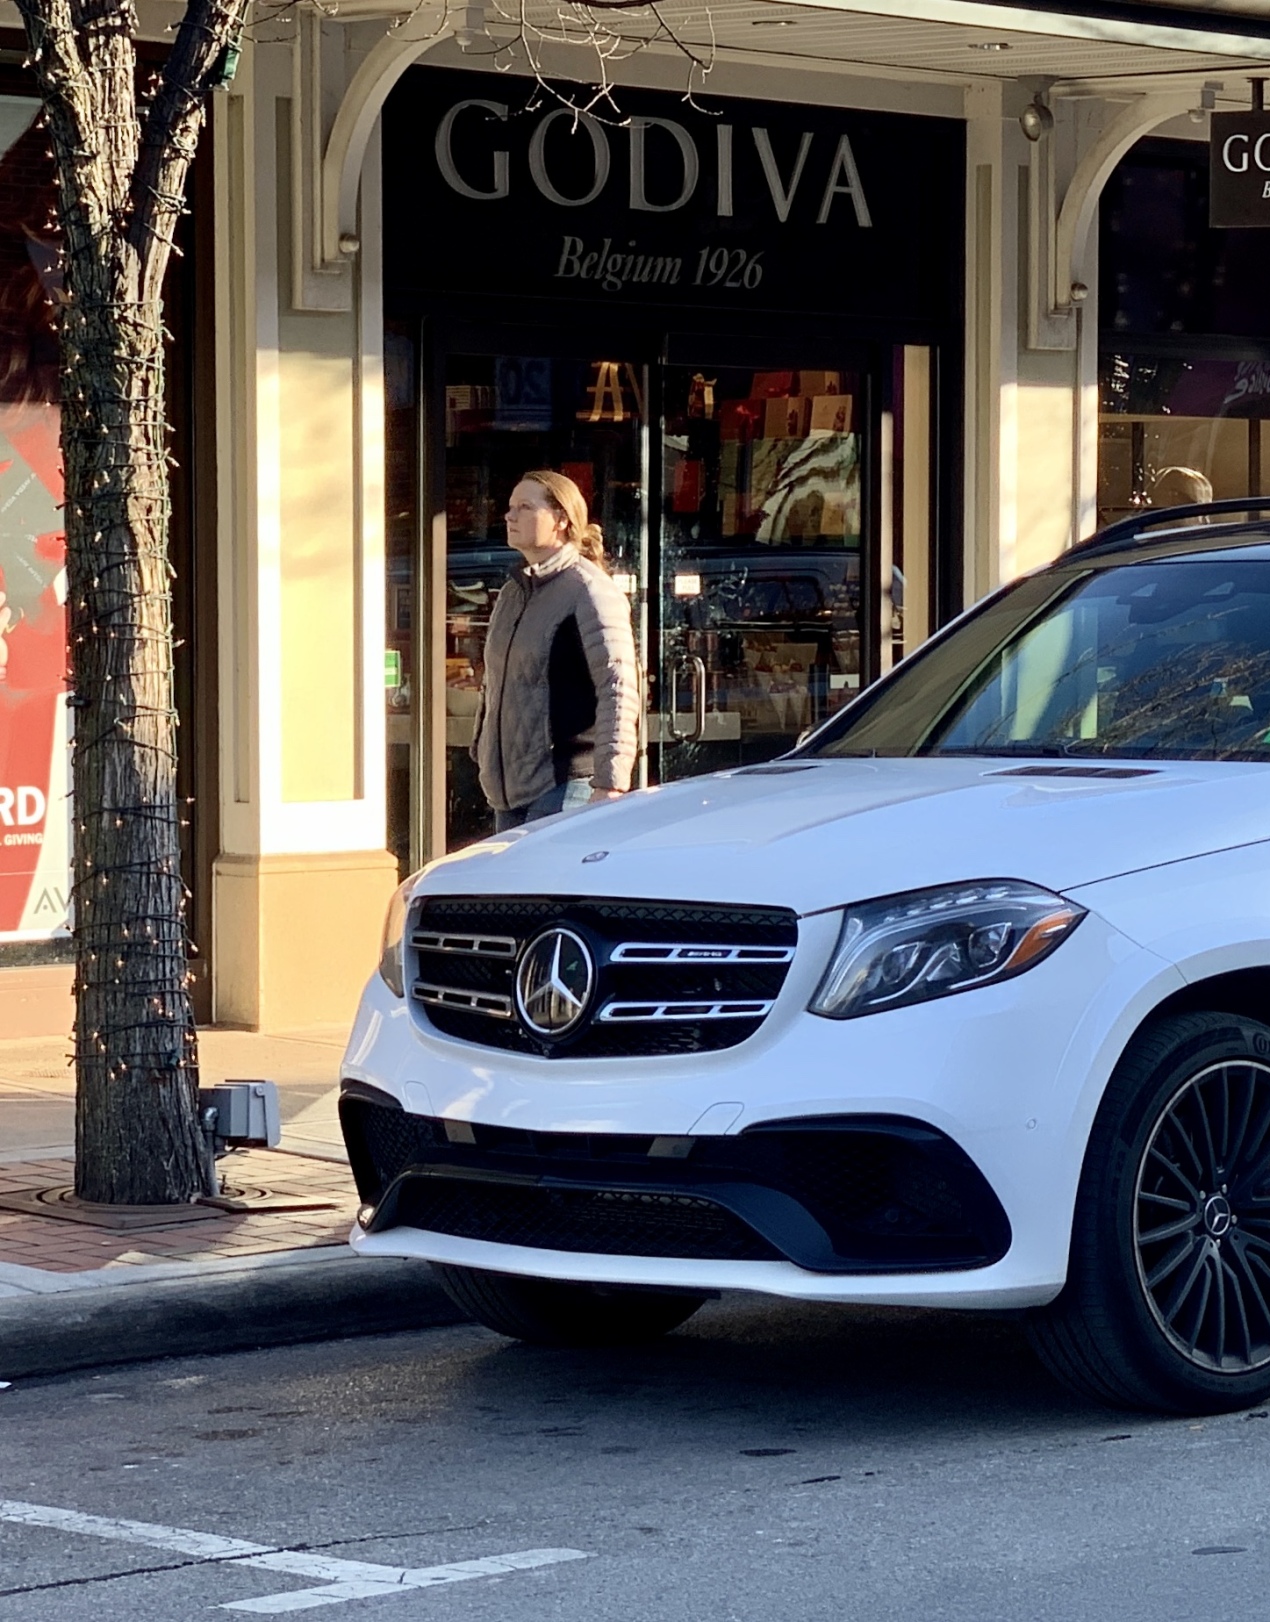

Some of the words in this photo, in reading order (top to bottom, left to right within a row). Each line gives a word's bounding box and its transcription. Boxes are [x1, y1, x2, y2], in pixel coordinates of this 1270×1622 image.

[434, 99, 873, 228] GODIVA
[554, 235, 682, 292] Belgium
[691, 245, 766, 289] 1926
[4, 833, 43, 846] GIVING
